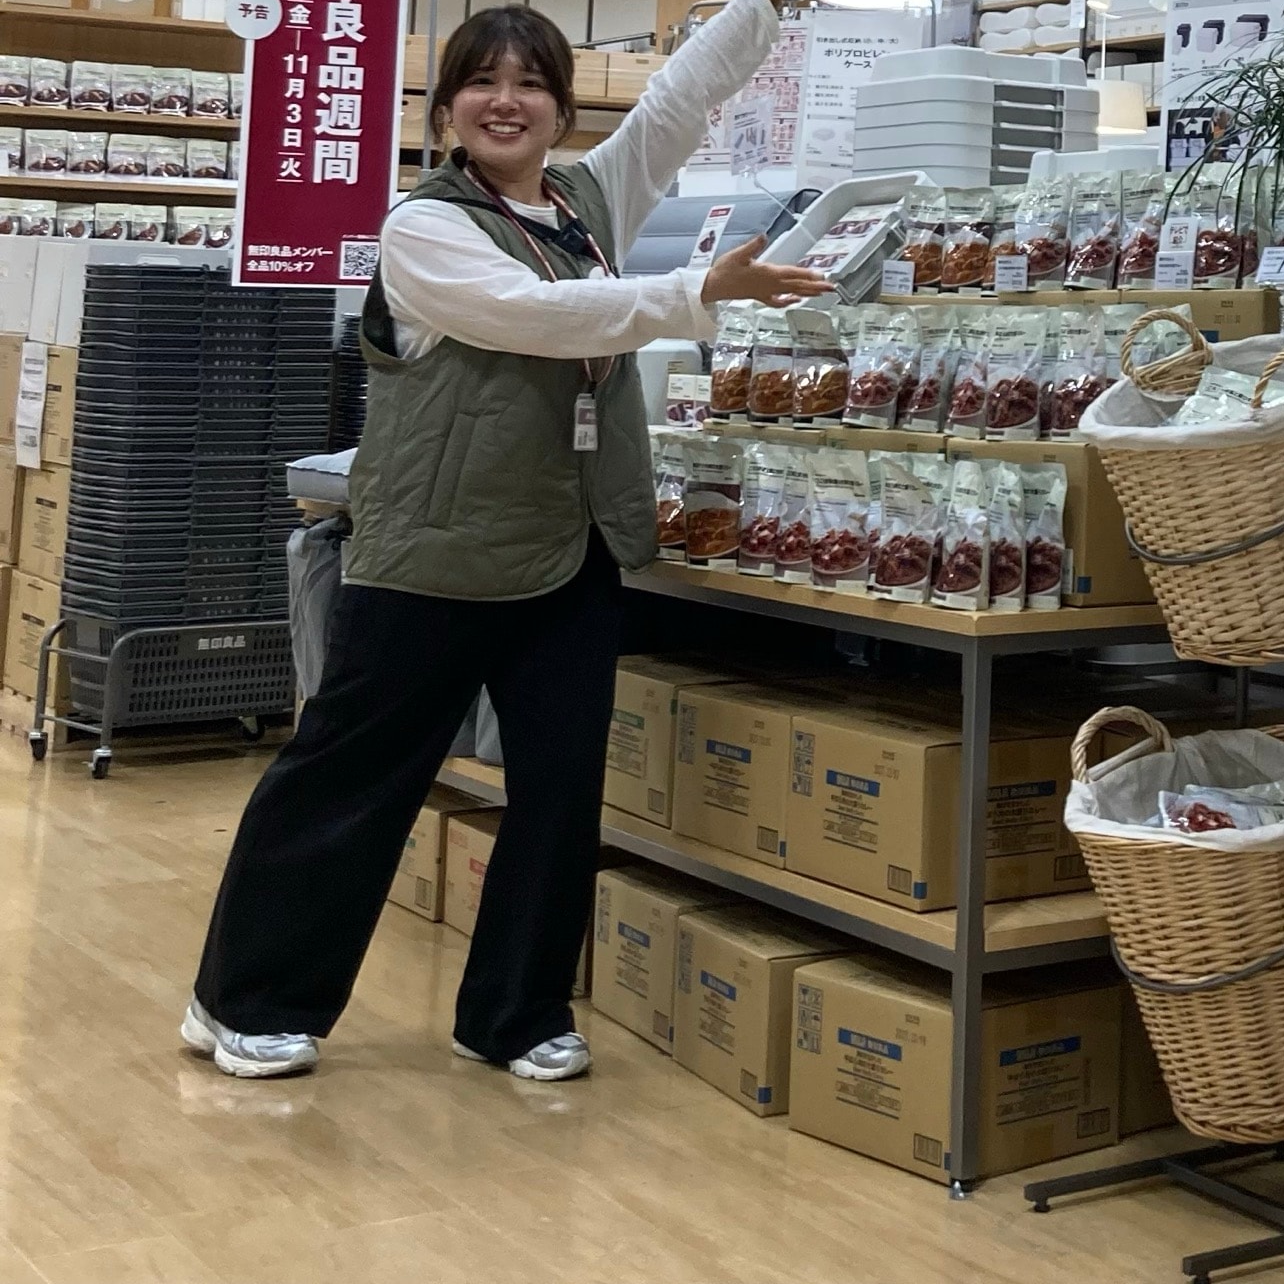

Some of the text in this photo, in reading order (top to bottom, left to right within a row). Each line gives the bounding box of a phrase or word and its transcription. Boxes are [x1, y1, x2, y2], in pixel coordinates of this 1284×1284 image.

[237, 2, 269, 21] 予告
[844, 60, 872, 68] ケース
[247, 244, 334, 257] 無印良品メンバー
[247, 260, 315, 272] 全品10%オフ
